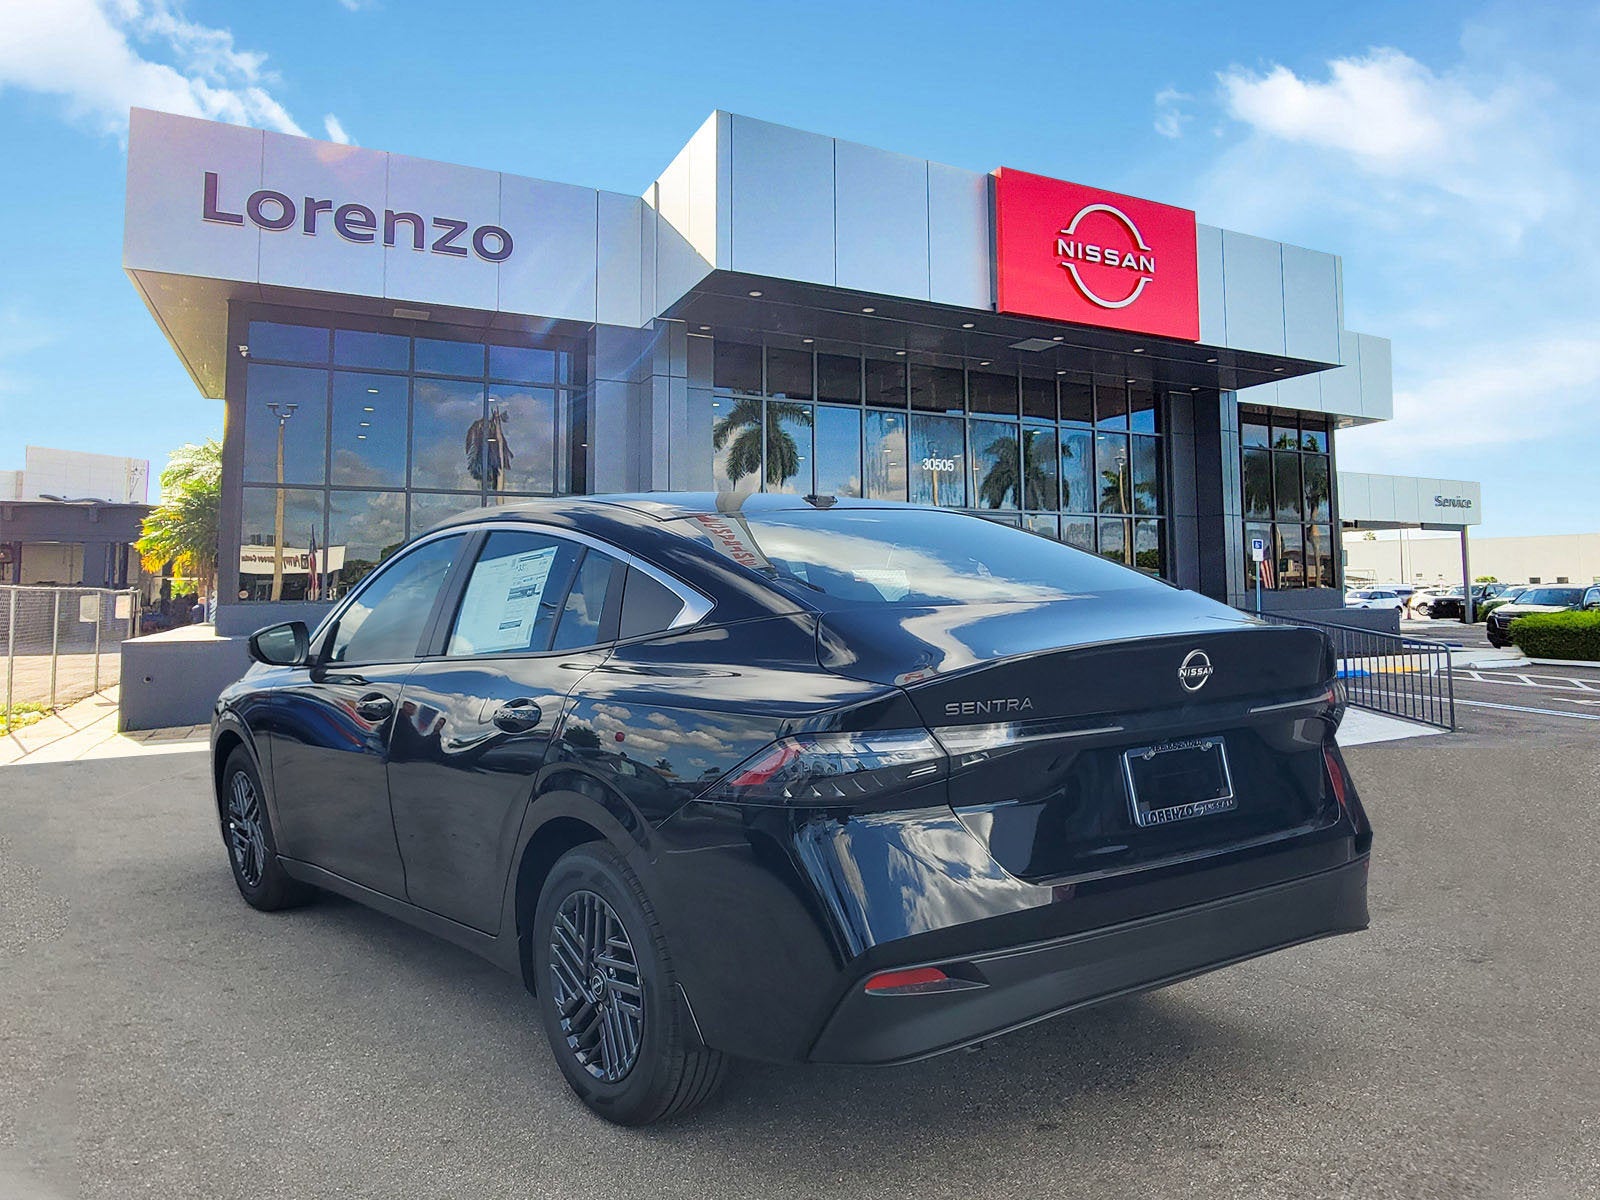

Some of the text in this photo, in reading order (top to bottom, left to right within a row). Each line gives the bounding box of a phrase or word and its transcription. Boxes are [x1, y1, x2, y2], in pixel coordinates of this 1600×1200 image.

[202, 171, 514, 262] Lorenzo
[1057, 238, 1155, 273] NISSAN
[922, 458, 955, 471] 30505
[1434, 495, 1472, 509] Service
[1179, 667, 1213, 677] NISSAN
[945, 697, 1034, 715] SENTRA
[1143, 804, 1195, 826] LORENZO
